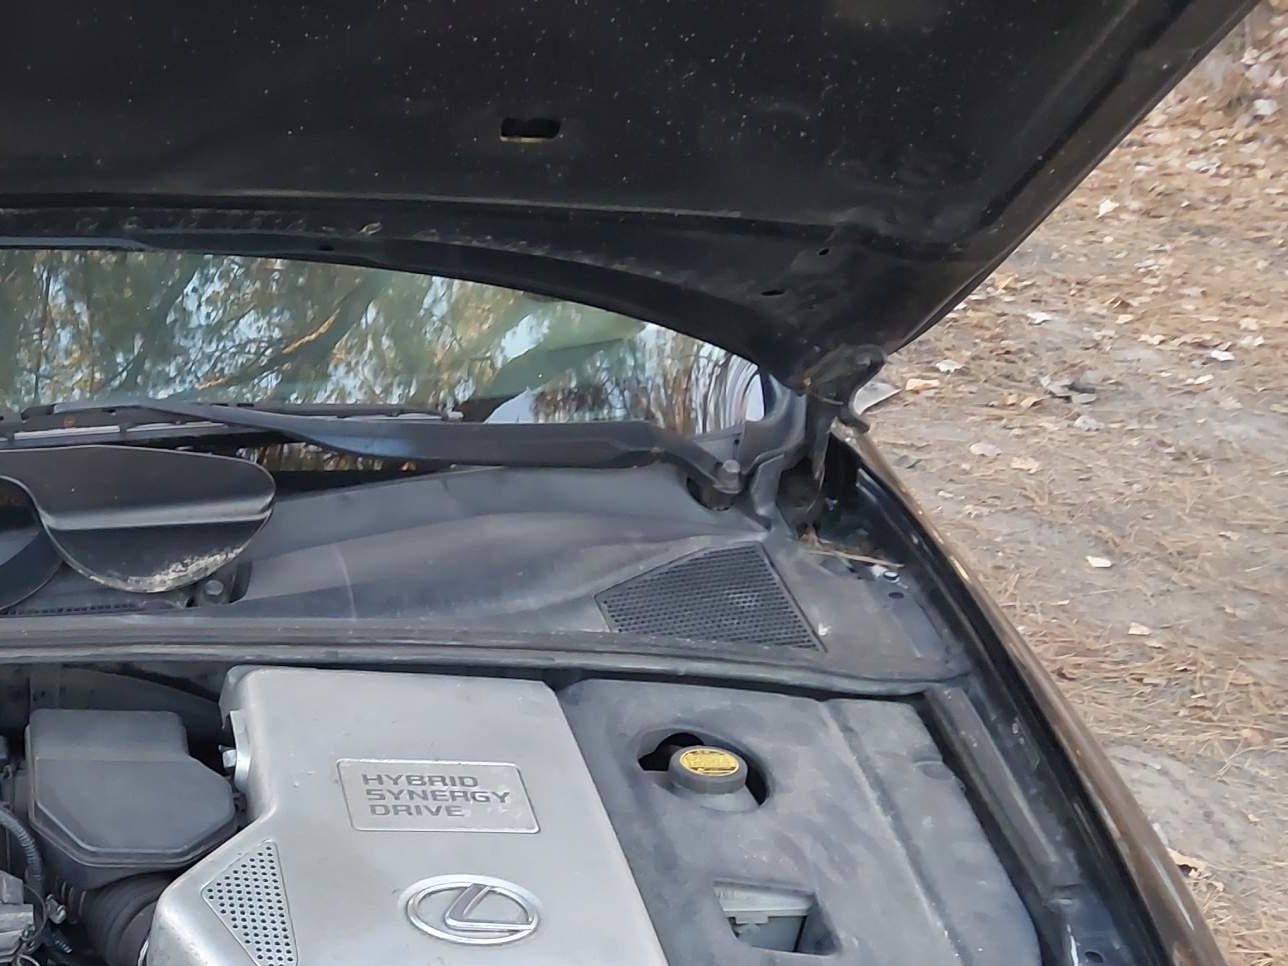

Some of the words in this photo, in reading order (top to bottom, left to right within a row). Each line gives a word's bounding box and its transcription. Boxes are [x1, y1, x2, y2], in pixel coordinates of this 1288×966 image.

[362, 774, 478, 787] HYBRID
[365, 789, 510, 803] SYNERGY
[369, 804, 465, 817] DRIVE
